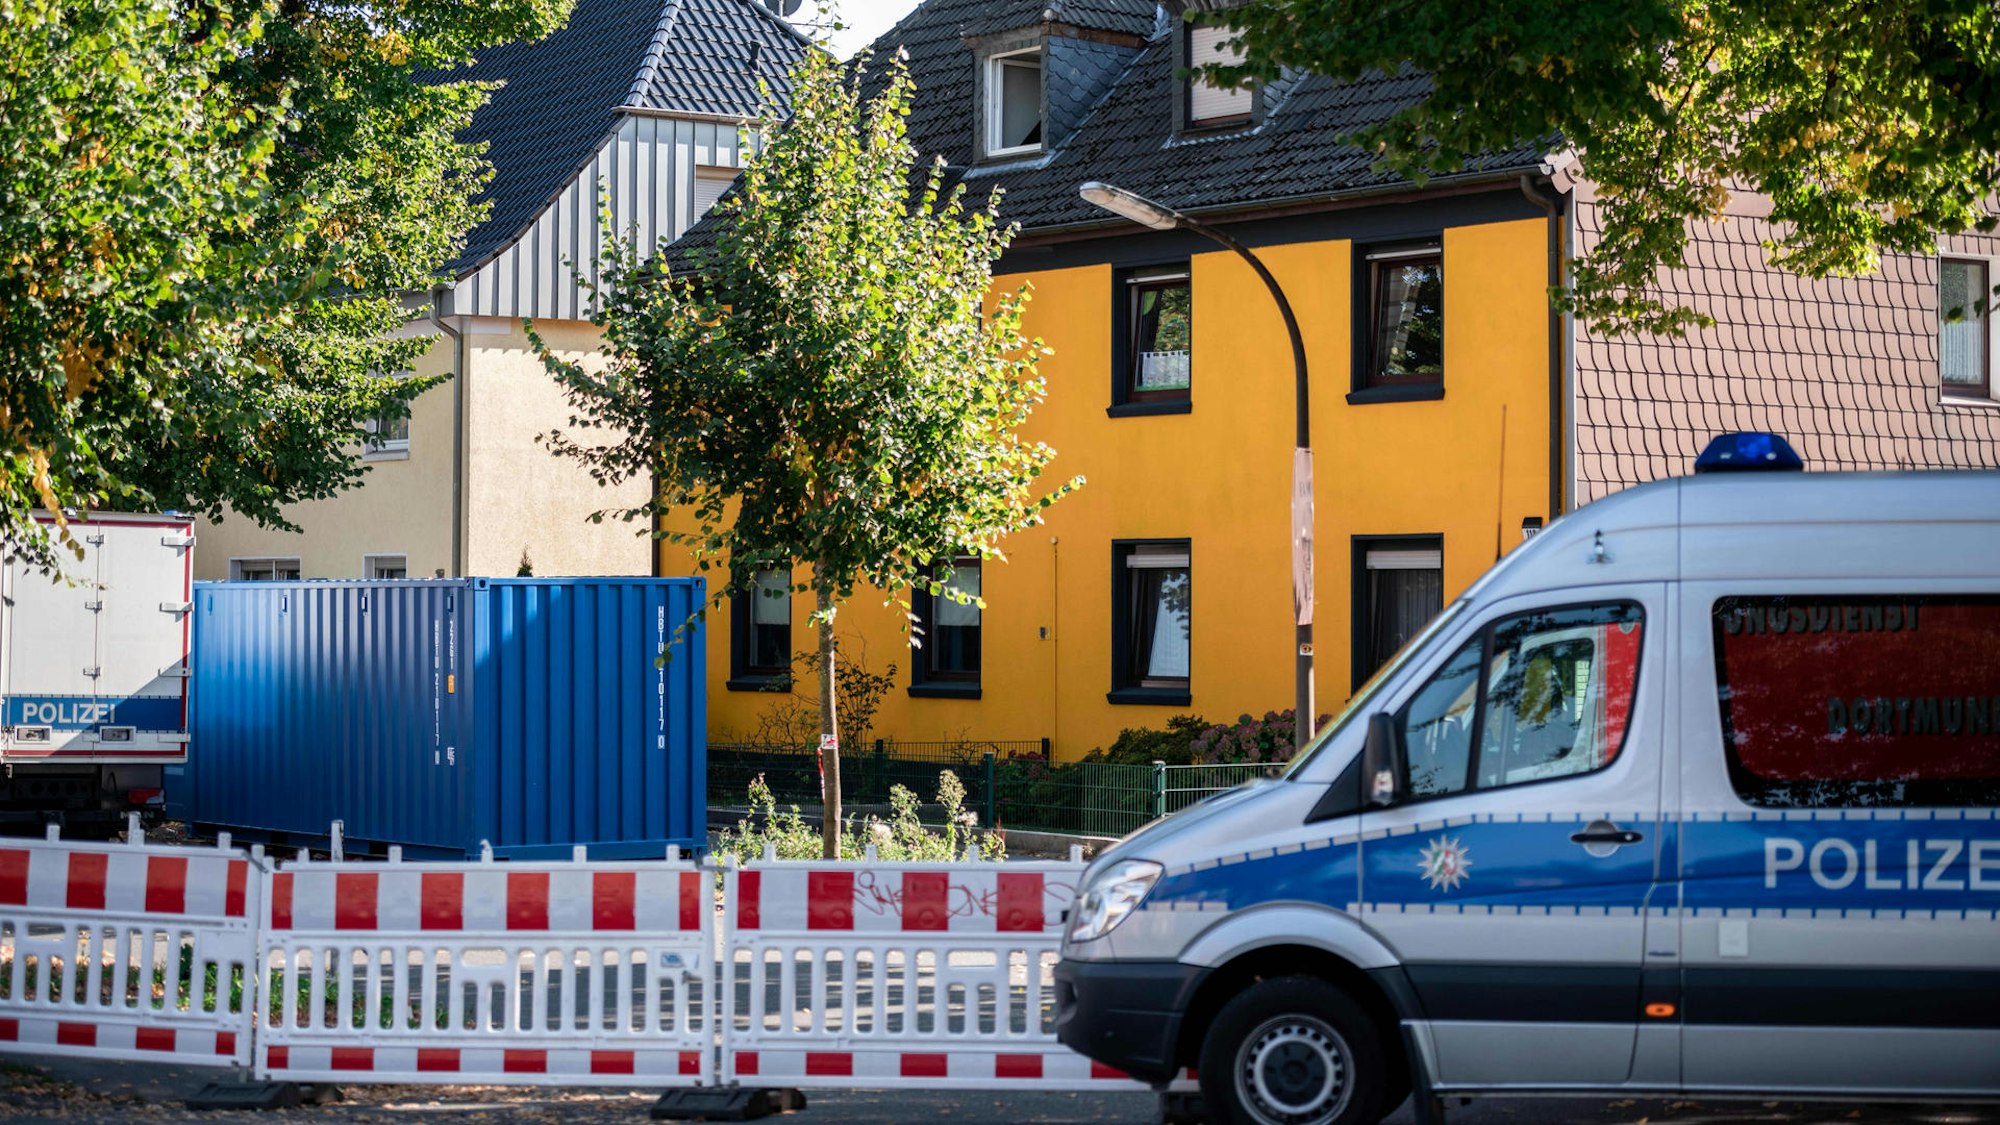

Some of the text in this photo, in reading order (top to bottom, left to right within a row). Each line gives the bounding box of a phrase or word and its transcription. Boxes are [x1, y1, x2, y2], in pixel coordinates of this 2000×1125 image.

[23, 702, 115, 723] POLIZEI
[120, 811, 154, 819] MN
[1765, 838, 2000, 890] POLIZE
